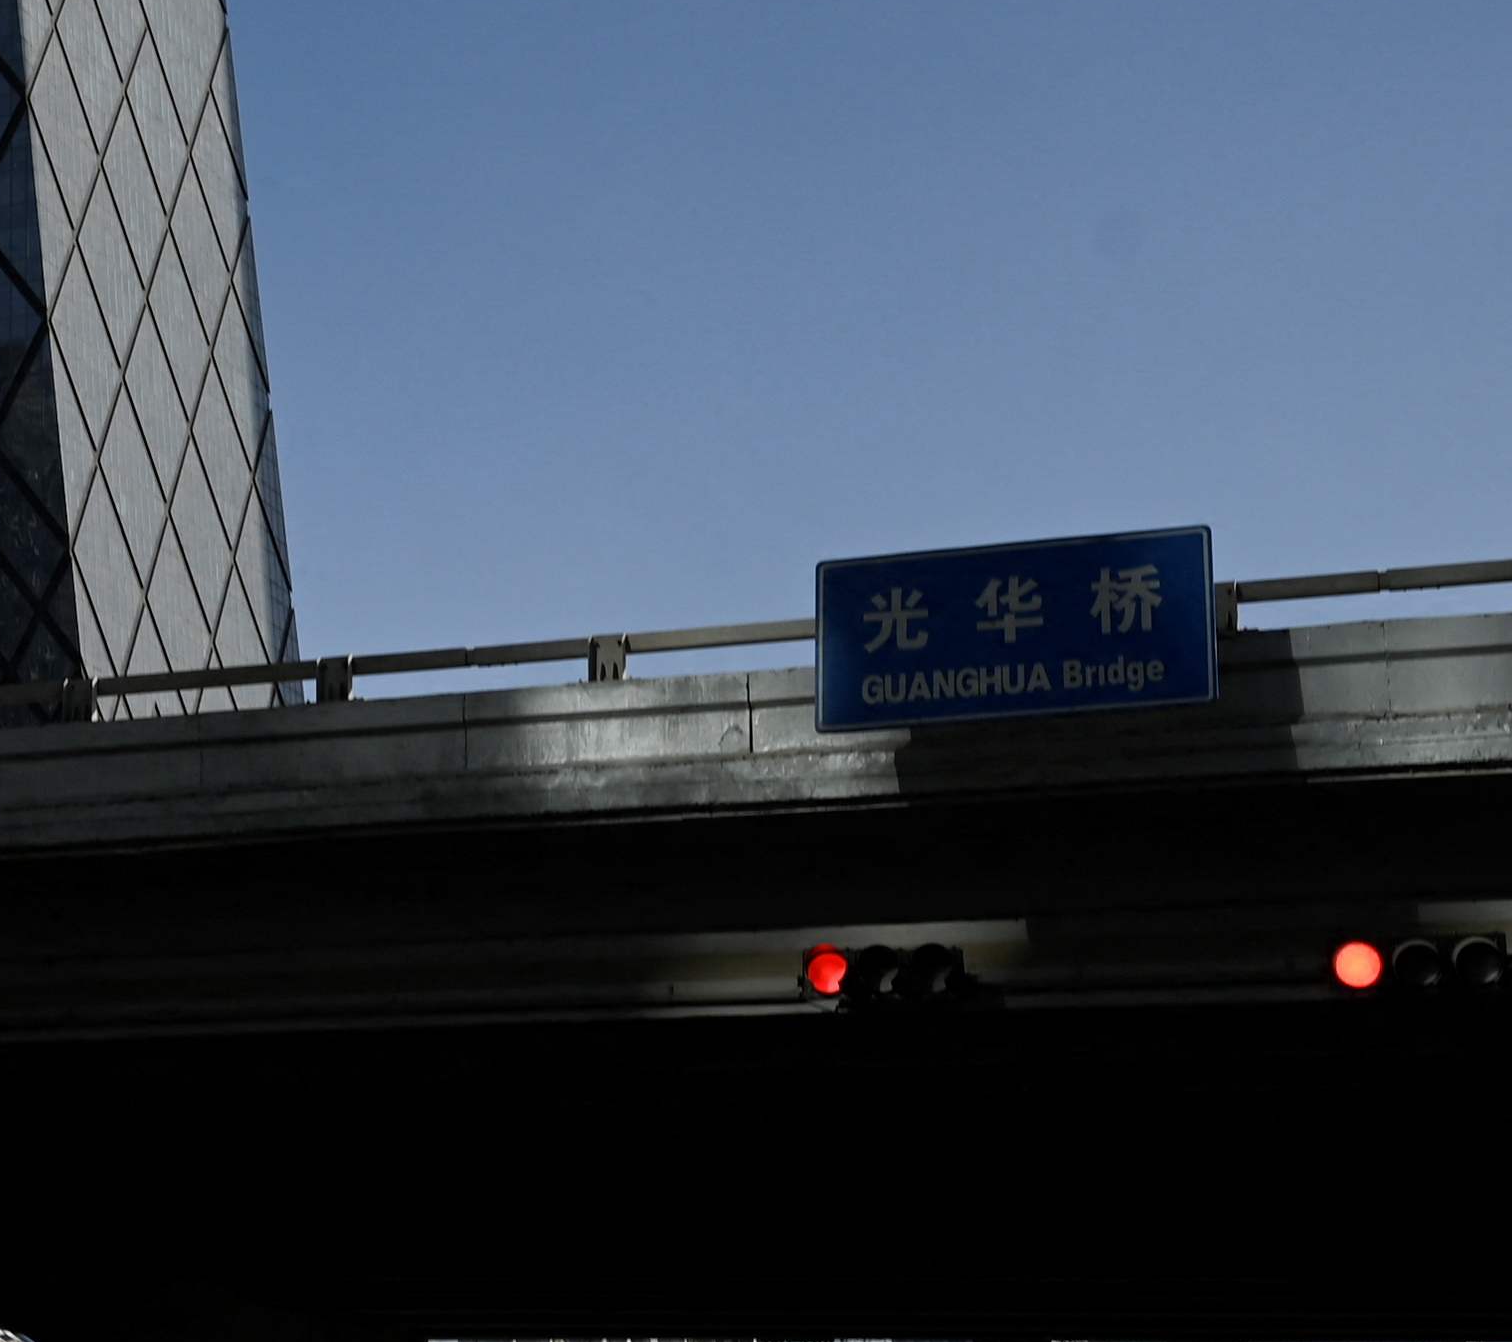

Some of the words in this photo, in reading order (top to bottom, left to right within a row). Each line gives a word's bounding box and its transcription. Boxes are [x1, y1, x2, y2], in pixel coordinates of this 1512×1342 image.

[863, 565, 1163, 653] 光华桥
[862, 661, 1052, 706] GUANGHUA
[1062, 655, 1165, 692] Bridge
